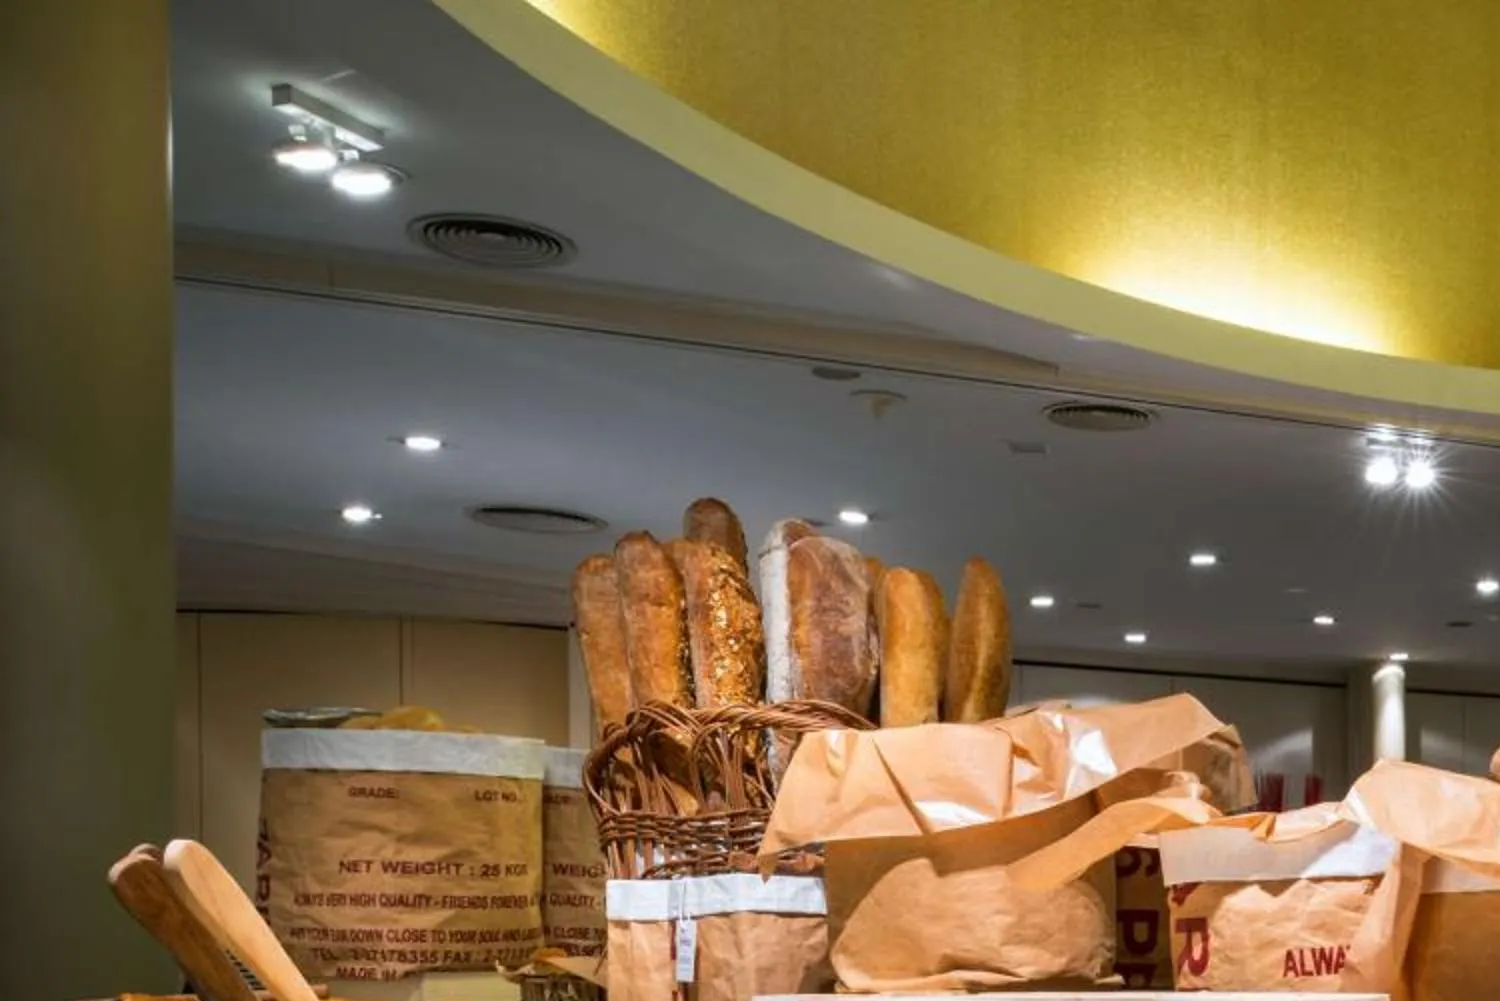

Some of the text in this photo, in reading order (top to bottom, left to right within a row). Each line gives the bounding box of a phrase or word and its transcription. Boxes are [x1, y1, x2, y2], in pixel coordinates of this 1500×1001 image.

[339, 859, 373, 875] NET
[380, 860, 465, 877] WEIGHT
[479, 863, 501, 878] 25
[349, 893, 376, 908] HIGH
[379, 893, 432, 911] QUALITY
[549, 894, 595, 911] QUALITY
[385, 928, 428, 943] CLOSE
[430, 929, 447, 944] TO
[1282, 944, 1350, 978] ALWA
